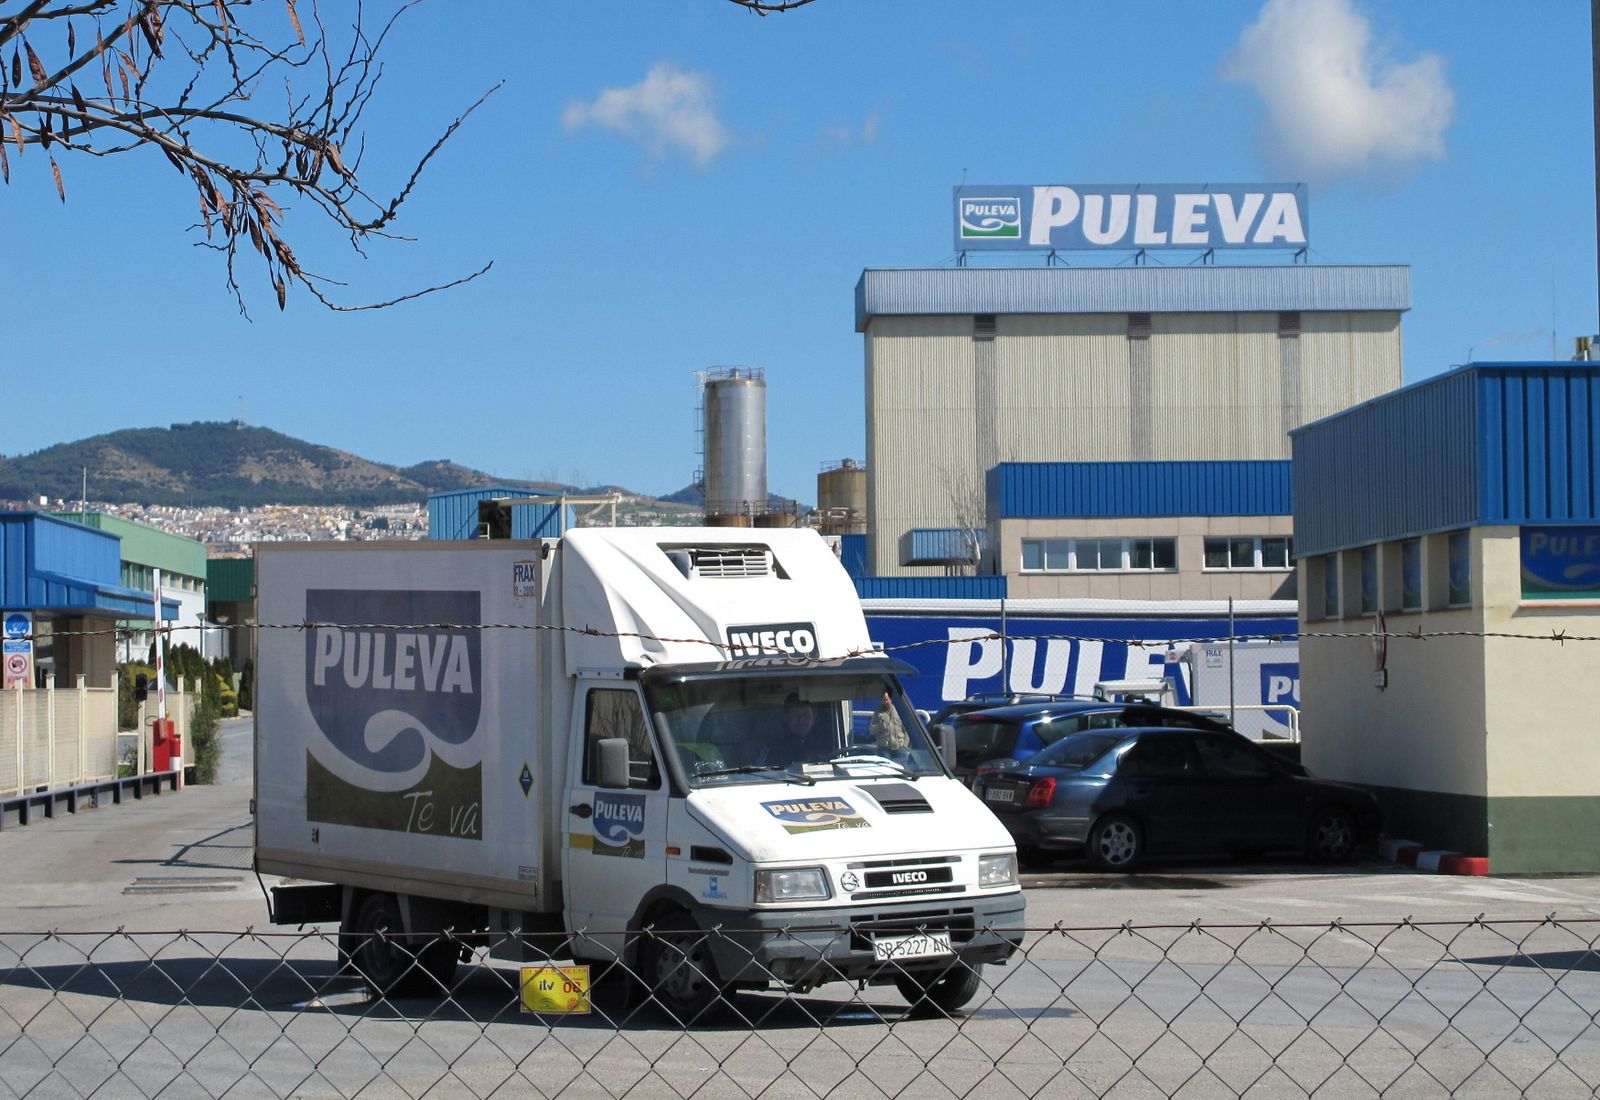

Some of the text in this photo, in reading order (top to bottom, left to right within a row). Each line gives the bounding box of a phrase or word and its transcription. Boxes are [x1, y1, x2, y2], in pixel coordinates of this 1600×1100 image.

[965, 203, 1016, 216] PULEVA
[1029, 186, 1307, 245] PULEVA
[513, 564, 535, 582] FRAX
[731, 629, 815, 657] IVECO
[313, 621, 474, 694] PULEVA
[403, 790, 479, 835] Te va
[594, 800, 643, 822] PULEVA
[768, 801, 851, 816] PULEVA
[892, 871, 927, 884] IVECO
